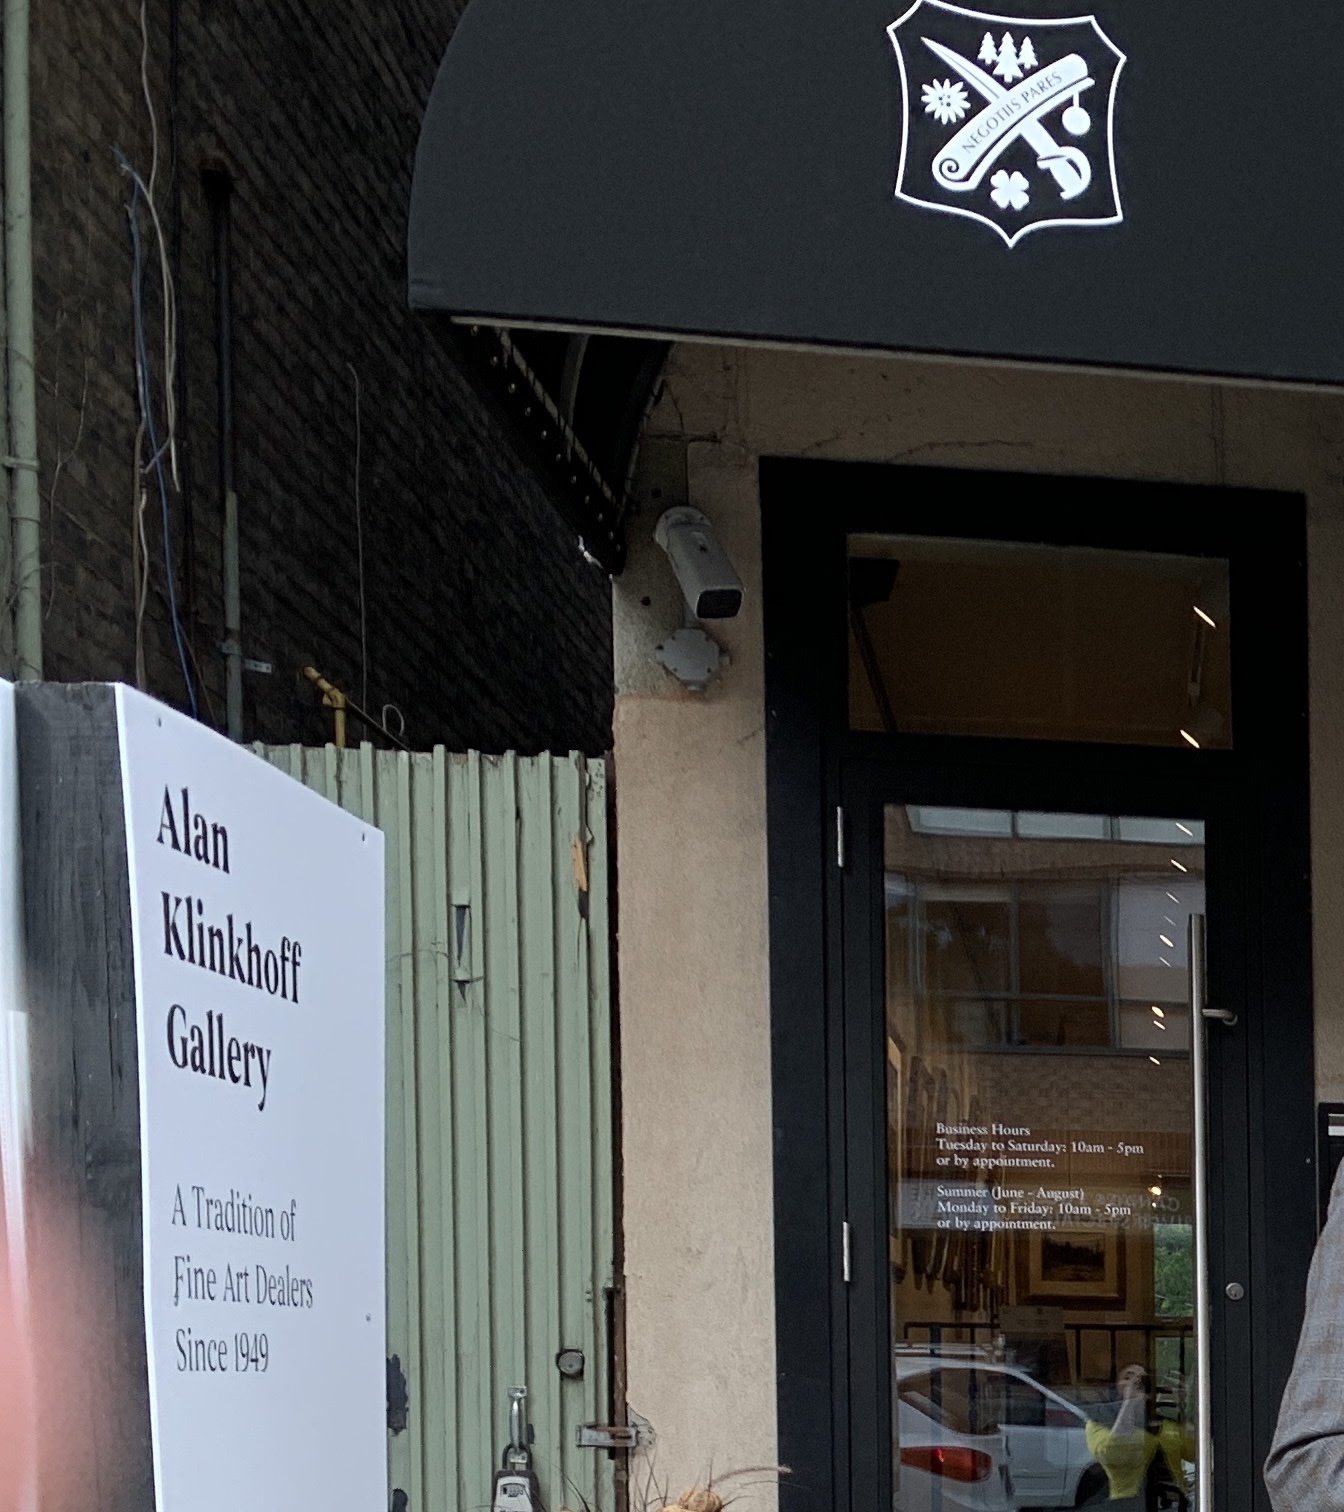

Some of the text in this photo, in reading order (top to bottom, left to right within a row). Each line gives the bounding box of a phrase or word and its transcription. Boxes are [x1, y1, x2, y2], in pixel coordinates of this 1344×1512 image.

[962, 71, 1062, 153] NEGOTIIS PARES
[156, 786, 230, 874] Alan
[161, 891, 302, 1004] Klinkhoff
[166, 1004, 272, 1112] Gallery
[936, 1122, 1031, 1136] Business Hours
[936, 1138, 988, 1153] Tuesday
[991, 1141, 1005, 1151] to
[1007, 1139, 1067, 1155] Saturday:
[1071, 1141, 1105, 1153] 10am
[1116, 1141, 1144, 1157] 5pm
[936, 1153, 1056, 1169] or by appointment.
[171, 1185, 297, 1242] A Tradition of
[936, 1184, 989, 1198] Summer
[991, 1186, 1025, 1200] (June
[1036, 1186, 1085, 1202] August)
[937, 1200, 989, 1216] Monday
[993, 1204, 1007, 1214] to
[1010, 1201, 1054, 1217] Friday:
[1059, 1202, 1092, 1215] 10am
[1103, 1203, 1131, 1218] 5pm
[936, 1219, 952, 1228] or
[955, 1215, 971, 1231] by
[974, 1218, 1057, 1231] appointment.
[173, 1254, 313, 1308] Fine Art Dealers
[176, 1327, 269, 1372] Since 1949
